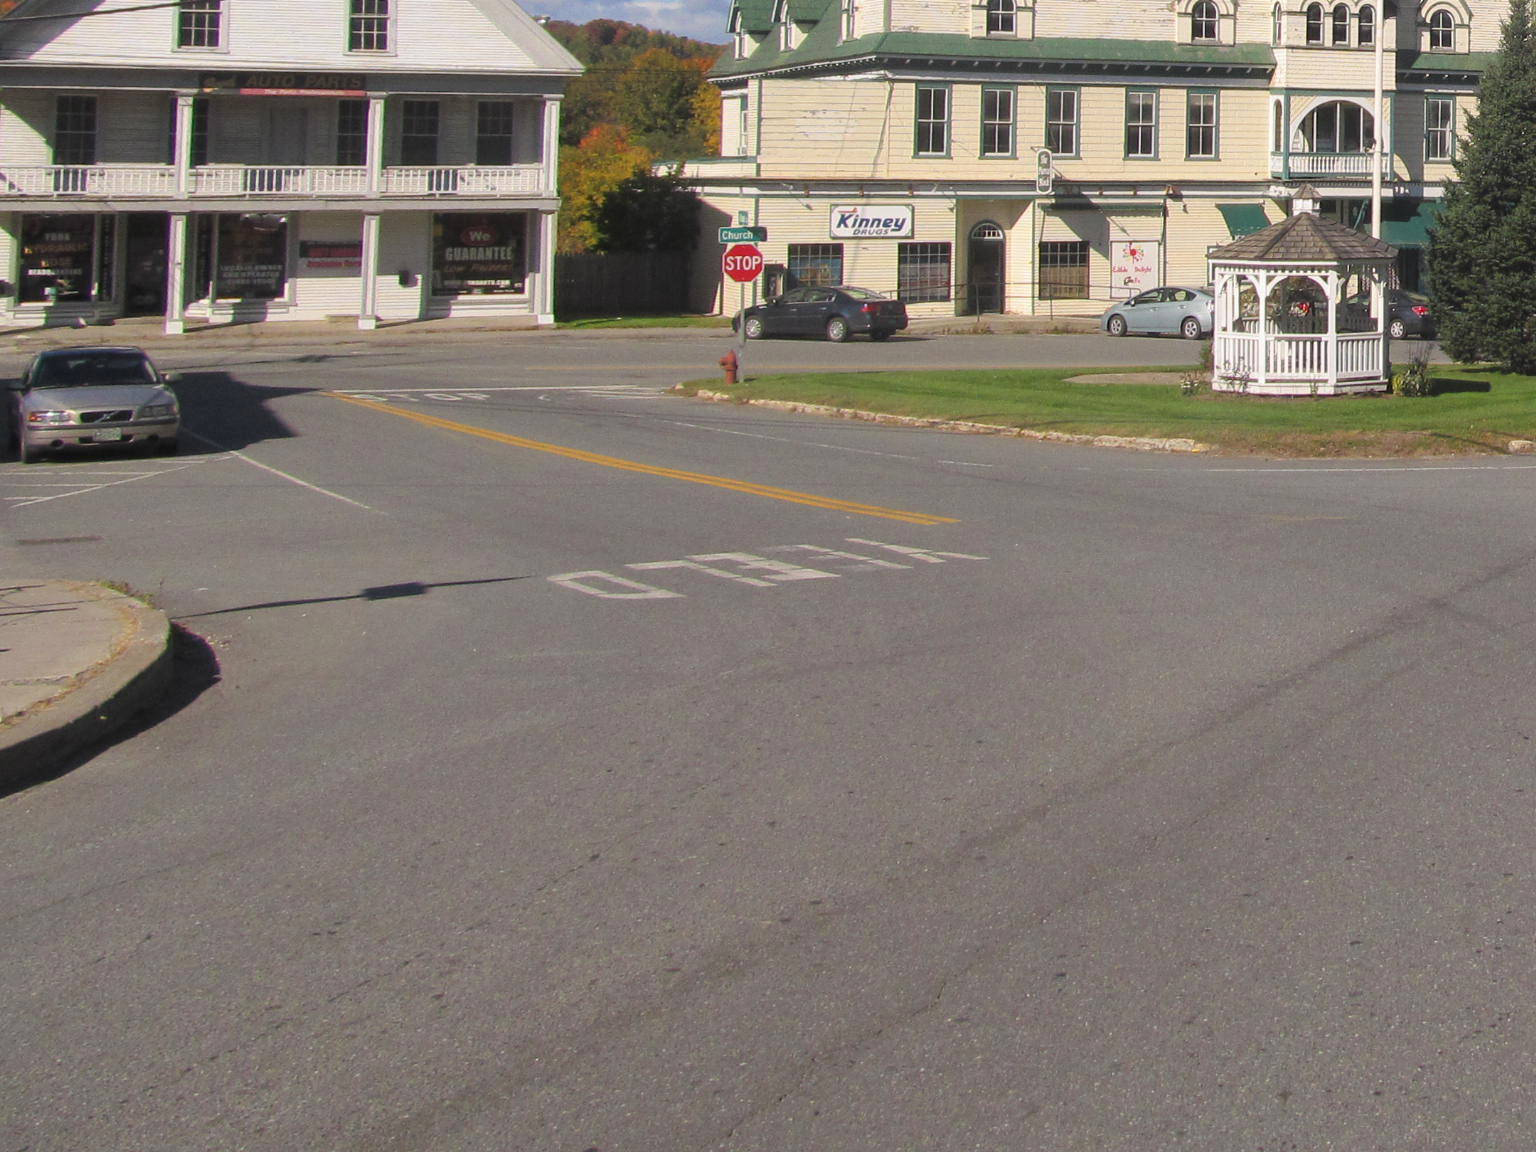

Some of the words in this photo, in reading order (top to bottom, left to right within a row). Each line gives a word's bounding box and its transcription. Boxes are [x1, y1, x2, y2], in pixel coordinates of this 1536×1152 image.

[246, 74, 296, 88] AUTO
[304, 75, 362, 89] PARTS
[836, 213, 906, 232] Kinney
[469, 231, 491, 242] We
[722, 230, 753, 239] Church
[446, 247, 513, 261] GUARANTEE
[726, 256, 761, 270] STOP
[350, 393, 490, 402] STOP
